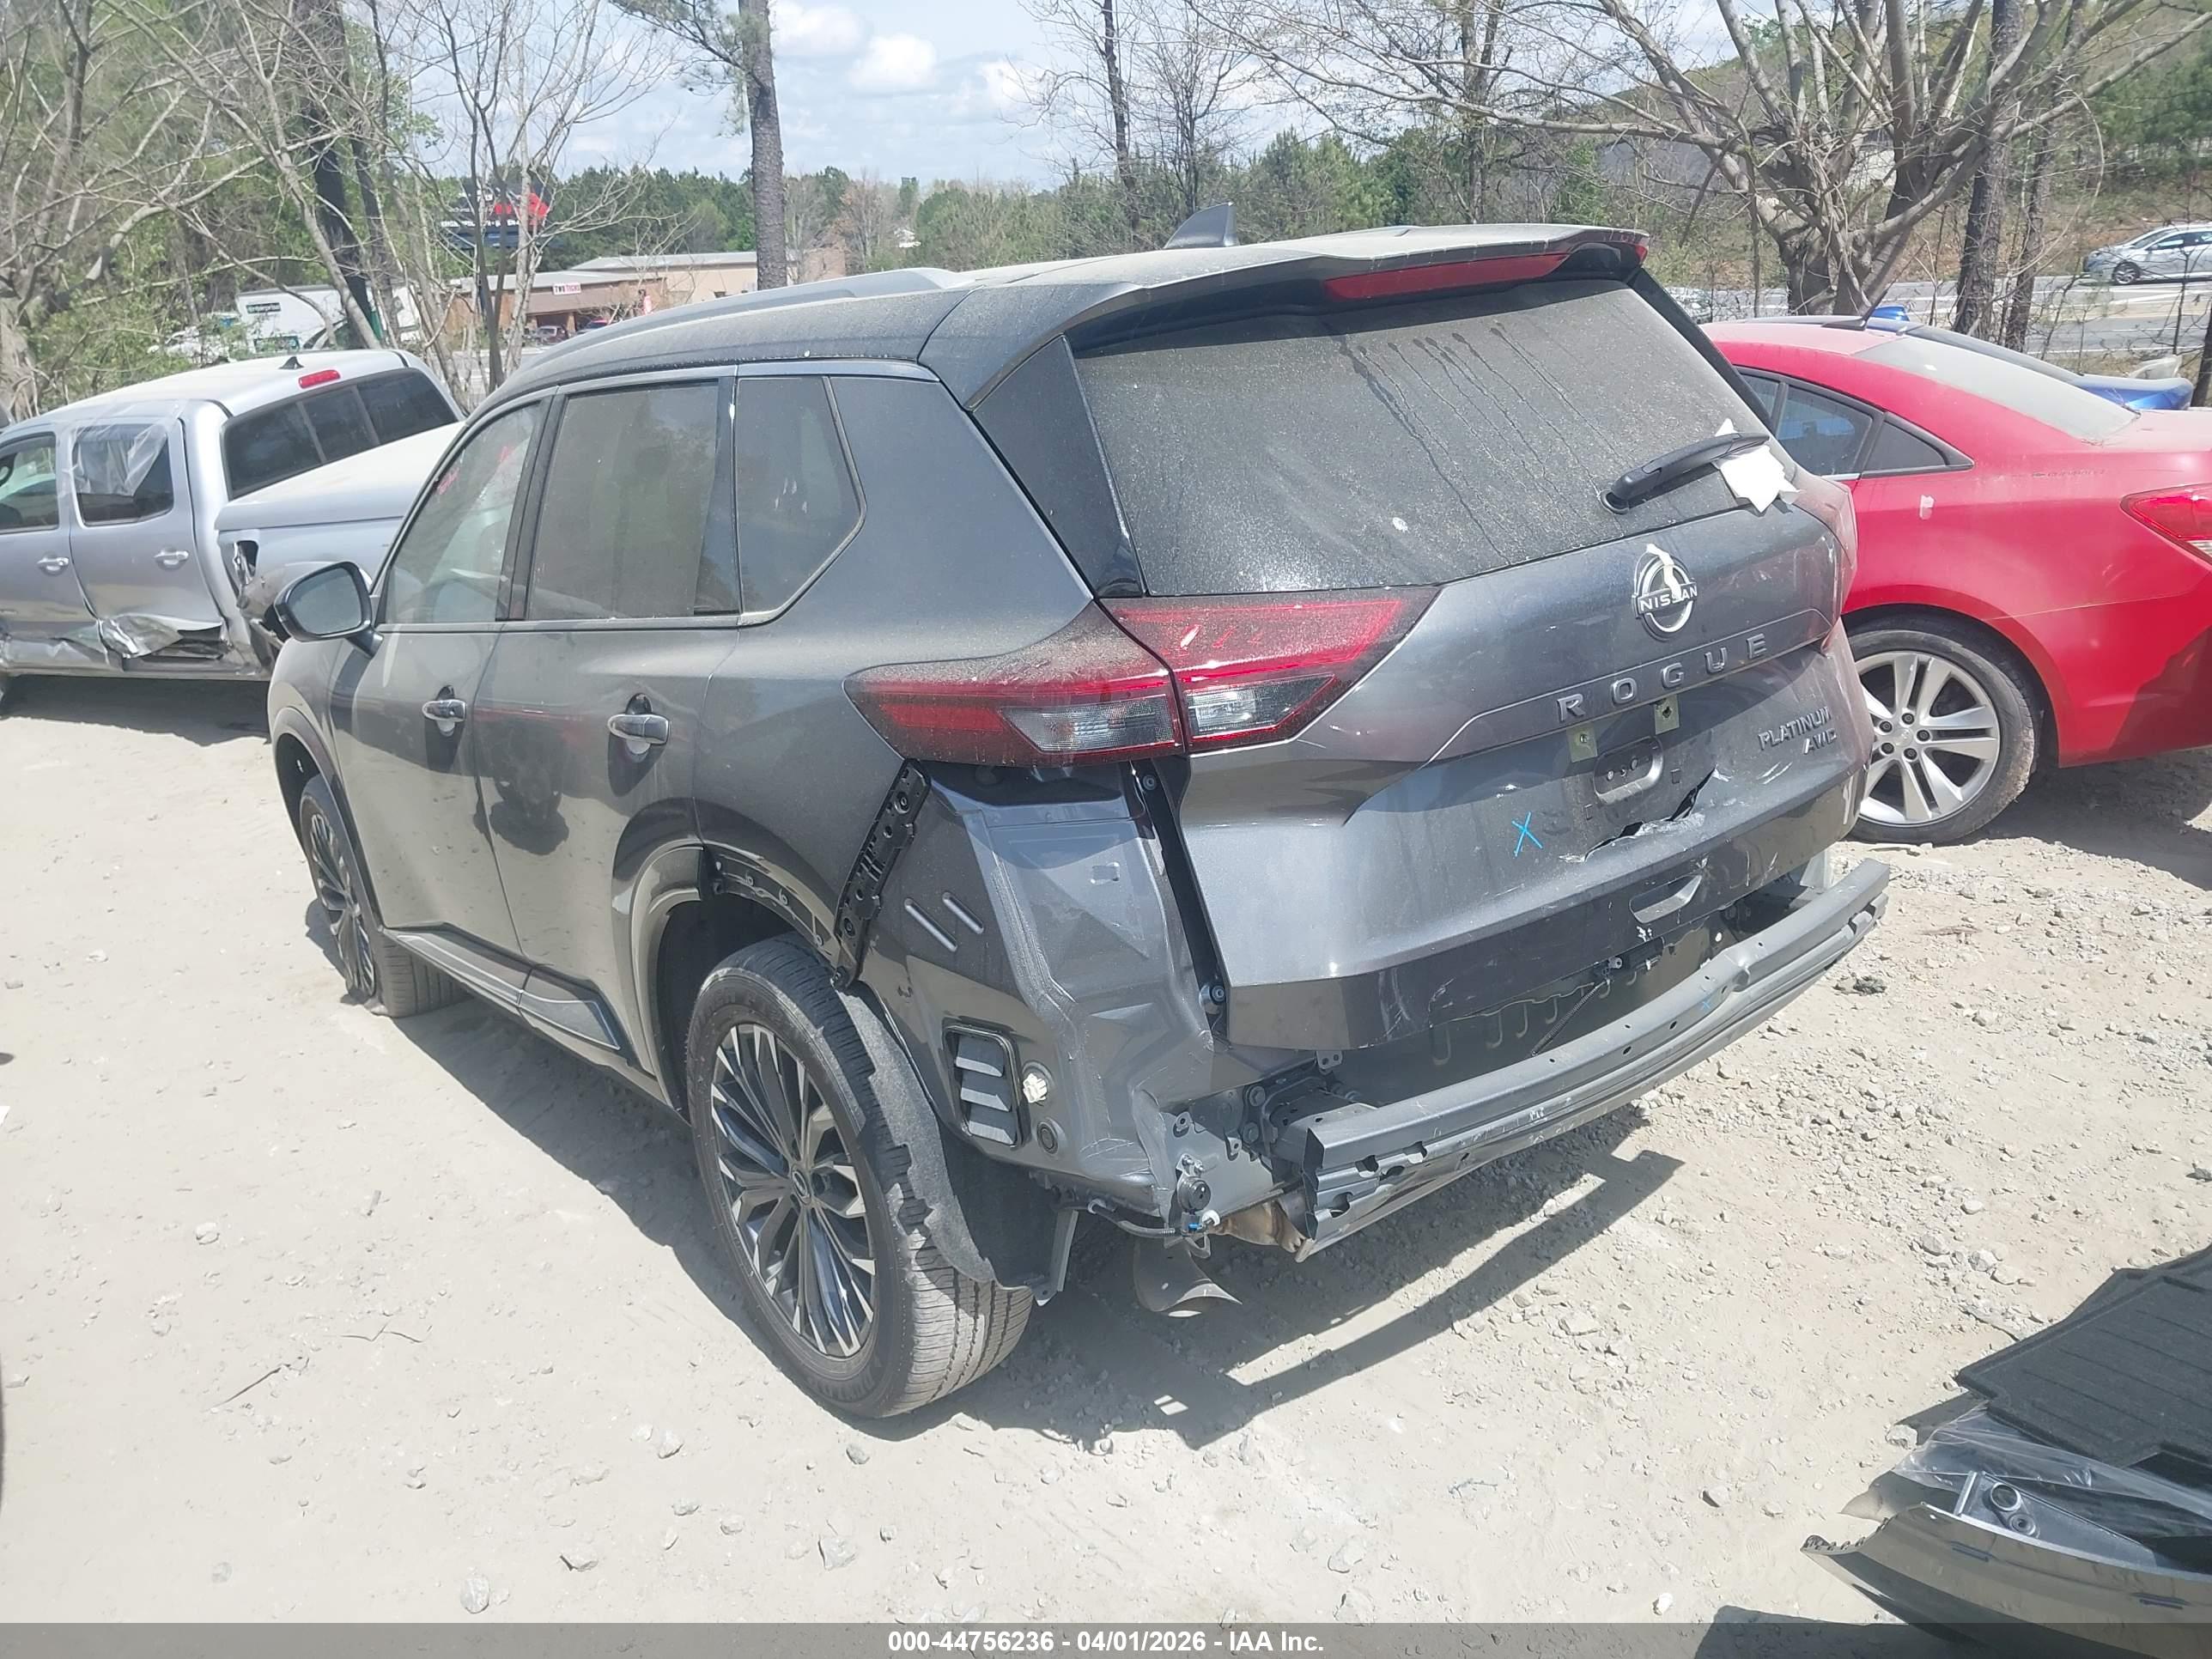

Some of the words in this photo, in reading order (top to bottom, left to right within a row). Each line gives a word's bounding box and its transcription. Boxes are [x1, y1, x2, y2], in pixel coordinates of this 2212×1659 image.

[1557, 633, 1767, 722] ROGUE
[1758, 707, 1832, 751] PLATINUM
[1803, 728, 1837, 755] AWD
